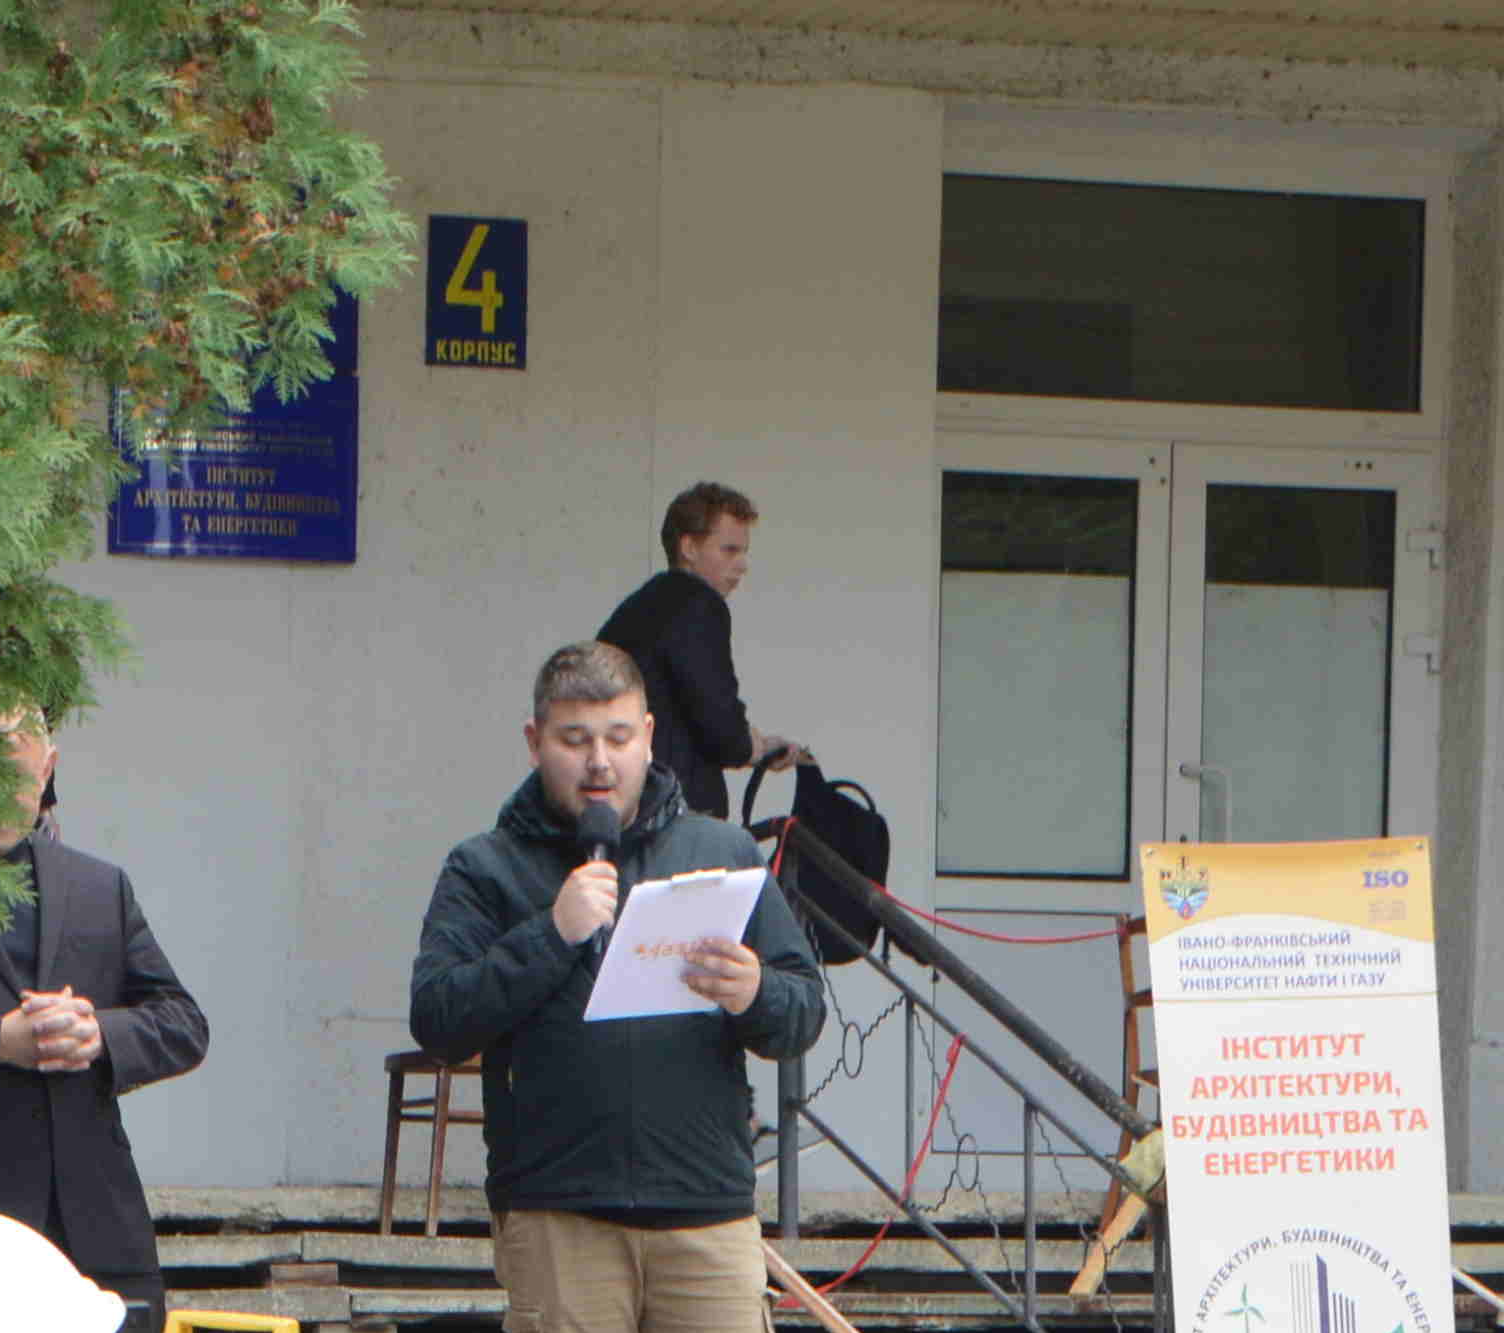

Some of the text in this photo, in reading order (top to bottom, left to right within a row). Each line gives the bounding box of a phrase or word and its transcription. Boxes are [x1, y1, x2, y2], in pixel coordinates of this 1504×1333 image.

[445, 223, 503, 333] 4
[435, 339, 516, 363] КОРПУС
[1363, 870, 1409, 888] ISO
[1178, 932, 1352, 949] ІВАНО-ФРАНКІВСЬКИЙ
[1179, 952, 1402, 972] НАЦІОНАЛЬНИЙ ТЕХНІЧНИЙ
[1181, 976, 1280, 992] УНІВЕРСИТЕТ
[1284, 974, 1338, 989] НАФТИ
[1350, 972, 1386, 987] ГАЗУ
[1221, 1033, 1366, 1061] ІНСТИТУТ
[1191, 1072, 1402, 1100] АРХІТЕКТУРИ,
[1171, 1107, 1430, 1142] БУДІВНИЦТВА ТА
[1281, 1228, 1390, 1272] БУДІВНИЦТВА
[1390, 1268, 1409, 1291] ТА
